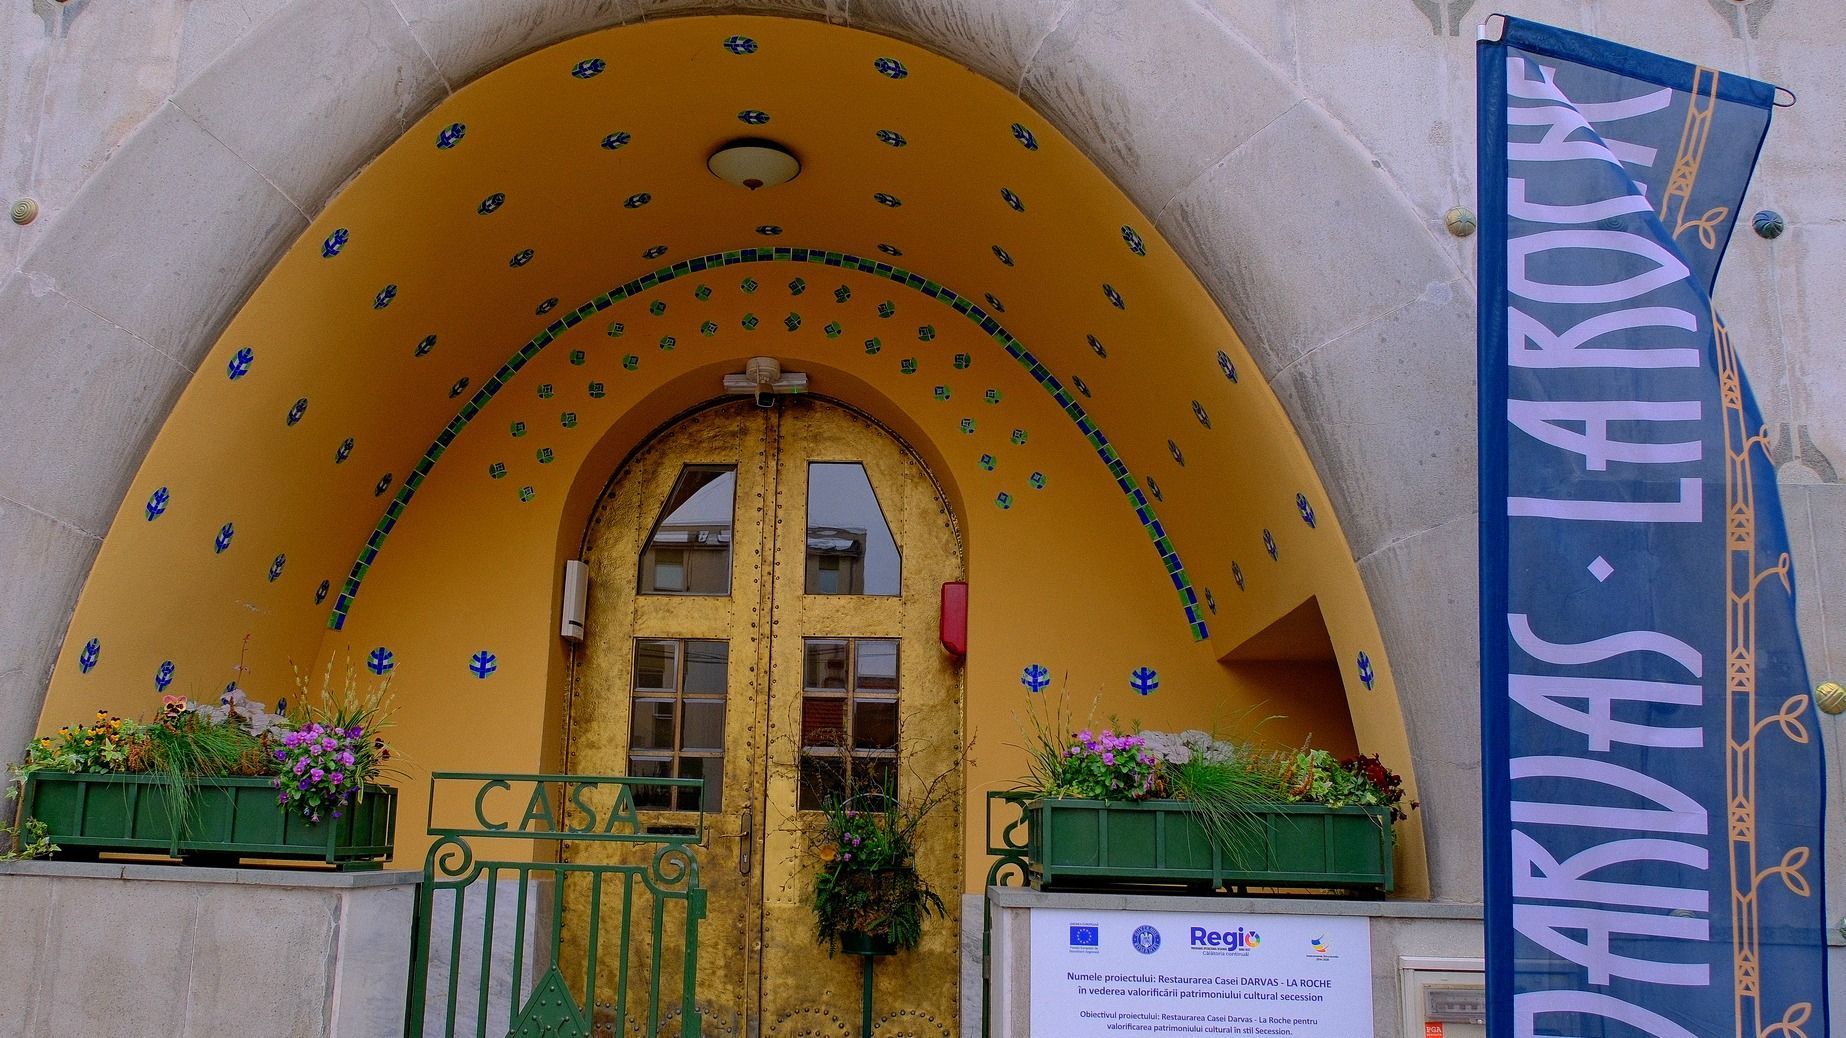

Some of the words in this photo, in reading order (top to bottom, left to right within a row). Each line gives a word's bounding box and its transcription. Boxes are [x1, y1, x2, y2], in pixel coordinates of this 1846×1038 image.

[1507, 400, 1702, 523] LA
[475, 780, 641, 834] CASA
[1067, 972, 1102, 981] Numele
[1104, 973, 1156, 983] proiectului:
[1158, 974, 1213, 985] Restaurarea
[1215, 976, 1239, 986] Casei
[1240, 977, 1279, 987] DARVAS
[1286, 978, 1298, 987] LA
[1300, 979, 1332, 988] ROCHE
[1078, 985, 1087, 994] în
[1089, 986, 1126, 996] vederea
[1127, 987, 1178, 997] valorificării
[1180, 989, 1241, 999] patrimoniului
[1243, 991, 1278, 1000] cultural
[1280, 992, 1323, 1002] secession
[1079, 1010, 1117, 1018] Obiectivul
[1118, 1012, 1160, 1020] proiectului:
[1161, 1013, 1206, 1022] Restaurarea
[1207, 1014, 1226, 1022] Casei
[1227, 1015, 1253, 1023] Darvas
[1259, 1016, 1267, 1024] La
[1268, 1016, 1292, 1024] Roche
[1293, 1017, 1318, 1026] pentru
[1106, 1023, 1152, 1031] valorificarea
[1153, 1024, 1203, 1033] patrimoniului
[1204, 1026, 1233, 1034] cultural
[1255, 1027, 1293, 1035] Secession.
